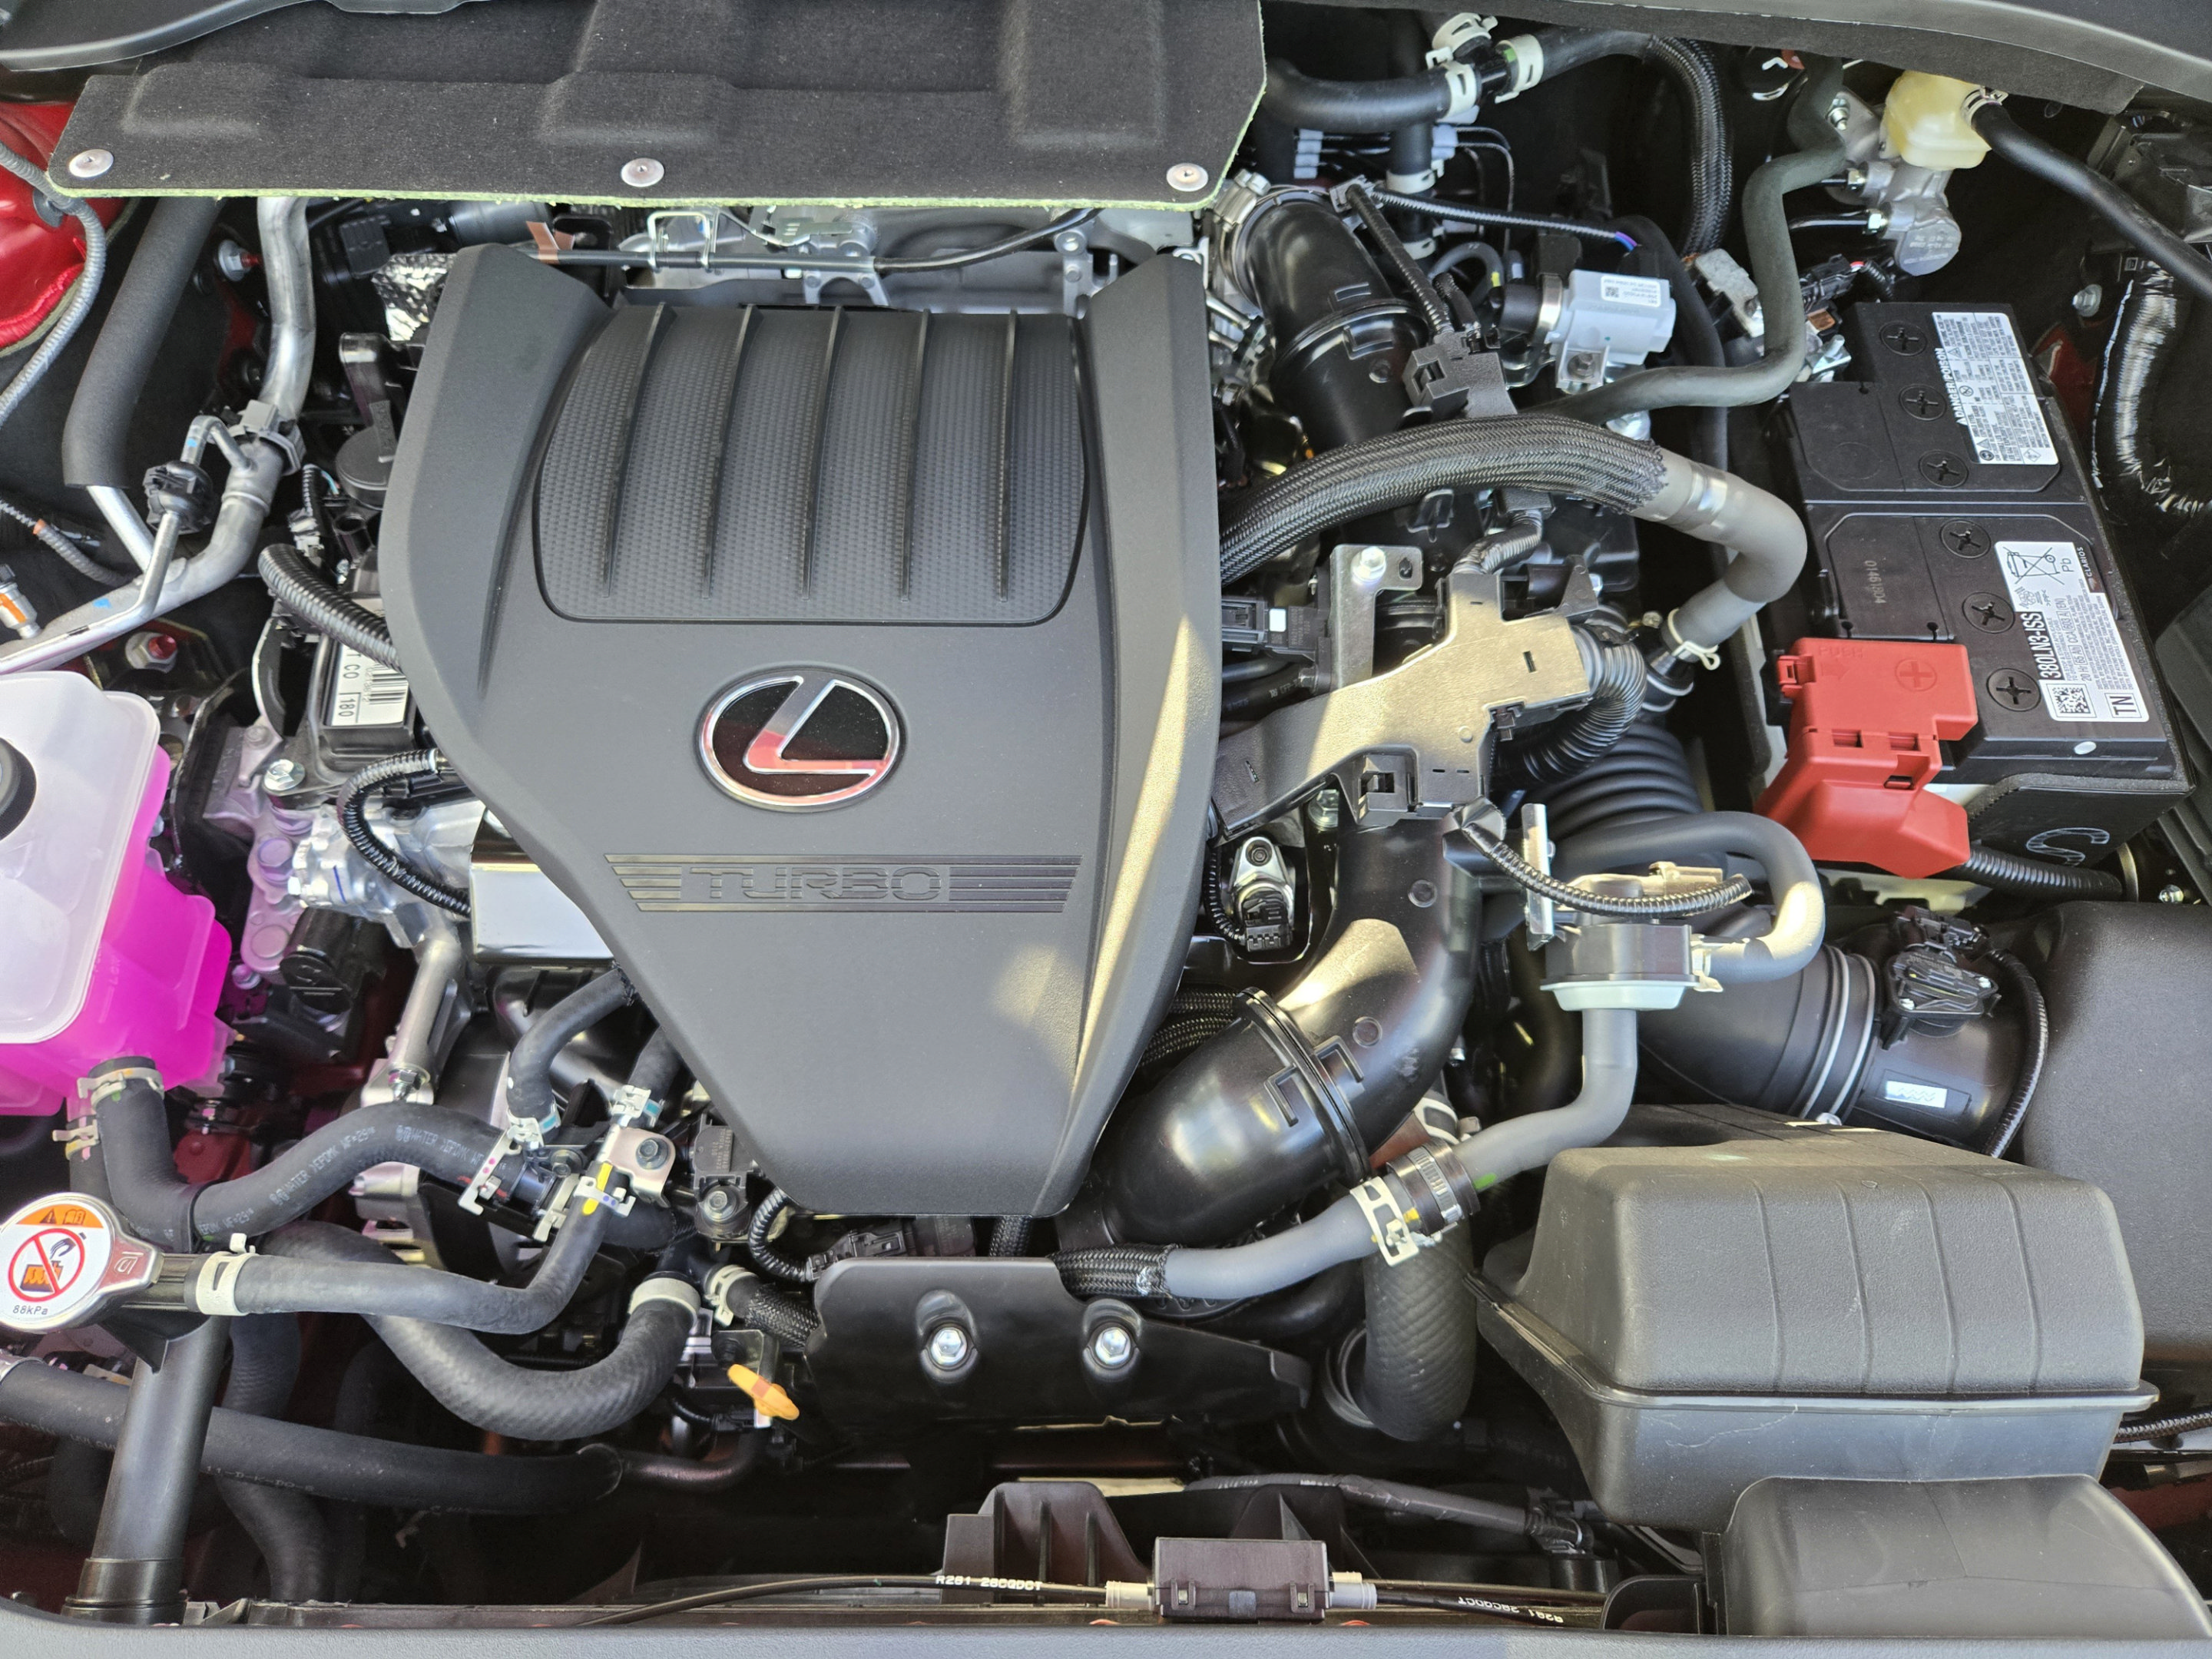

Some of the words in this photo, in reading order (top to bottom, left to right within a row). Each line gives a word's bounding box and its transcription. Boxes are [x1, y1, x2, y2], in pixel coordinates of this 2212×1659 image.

[1935, 348, 1963, 418] DANGER/POISON
[2063, 558, 2075, 574] Pb
[2077, 546, 2092, 578] CLARIOS
[2052, 598, 2068, 610] (EN)
[2059, 618, 2074, 629] 603
[2064, 631, 2079, 643] CCA
[2020, 612, 2060, 679] 380LN3-ISS
[2069, 646, 2082, 654] Ah
[2072, 654, 2085, 663] 65
[343, 664, 361, 680] CO
[2079, 673, 2092, 681] 20
[338, 698, 356, 718] 180
[2113, 694, 2137, 715] TN
[690, 866, 942, 902] TURBO
[12, 1304, 48, 1316] 88kPa
[935, 1575, 971, 1585] R281
